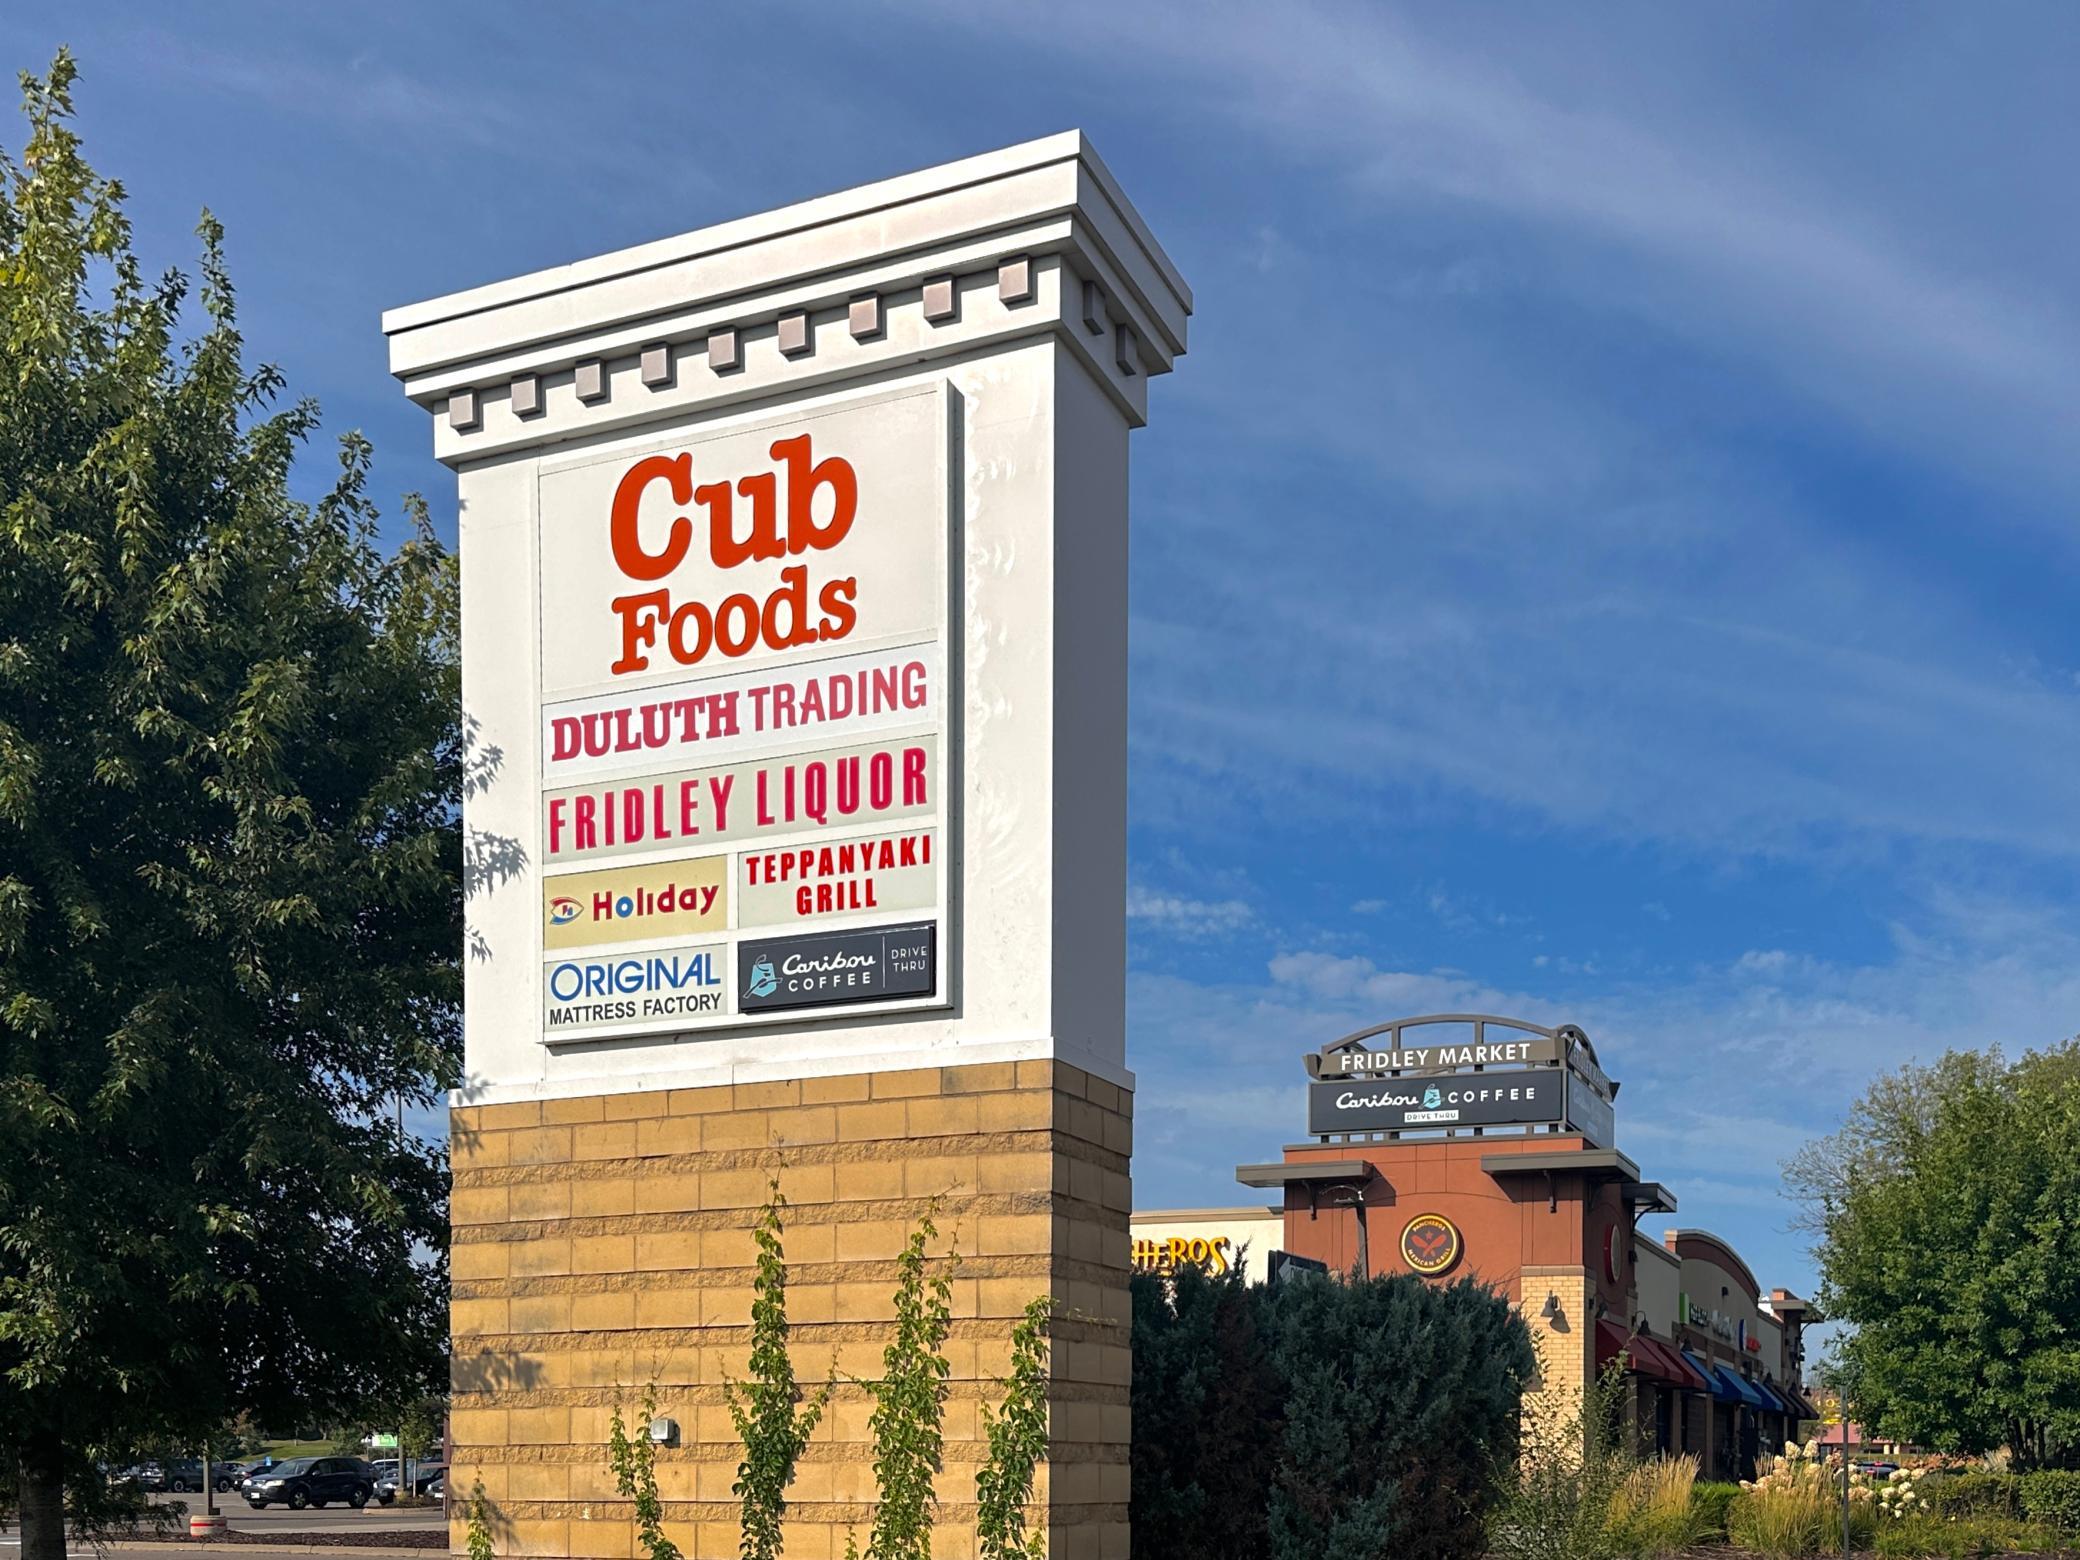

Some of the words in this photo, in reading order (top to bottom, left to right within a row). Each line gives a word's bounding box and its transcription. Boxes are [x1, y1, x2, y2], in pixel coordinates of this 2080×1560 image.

[611, 433, 858, 581] Cub
[611, 564, 857, 675] Foods
[551, 690, 740, 762] DULUTH
[747, 661, 927, 731] TRADING
[549, 774, 735, 854] FRIDLEY
[756, 746, 928, 826] LIQUOR
[745, 834, 931, 886] TEPPANYAKI
[593, 883, 720, 922] Holiday
[796, 878, 877, 916] GRILL
[782, 951, 876, 975] Caribou
[891, 946, 928, 960] DRIVE
[893, 960, 926, 972] THRU
[550, 952, 721, 1002] ORIGINAL
[788, 971, 871, 992] COFFEE
[549, 1001, 636, 1026] MATTRESS
[643, 992, 722, 1016] FACTORY
[1341, 1049, 1429, 1072] FRIDLEY
[1438, 1043, 1531, 1065] MARKET
[1336, 1092, 1419, 1109] Caribou
[1447, 1087, 1536, 1104] COFFEE
[1406, 1113, 1431, 1121] DRIVE
[1408, 1248, 1435, 1266] MEXICAN
[1436, 1248, 1451, 1264] GRILL
